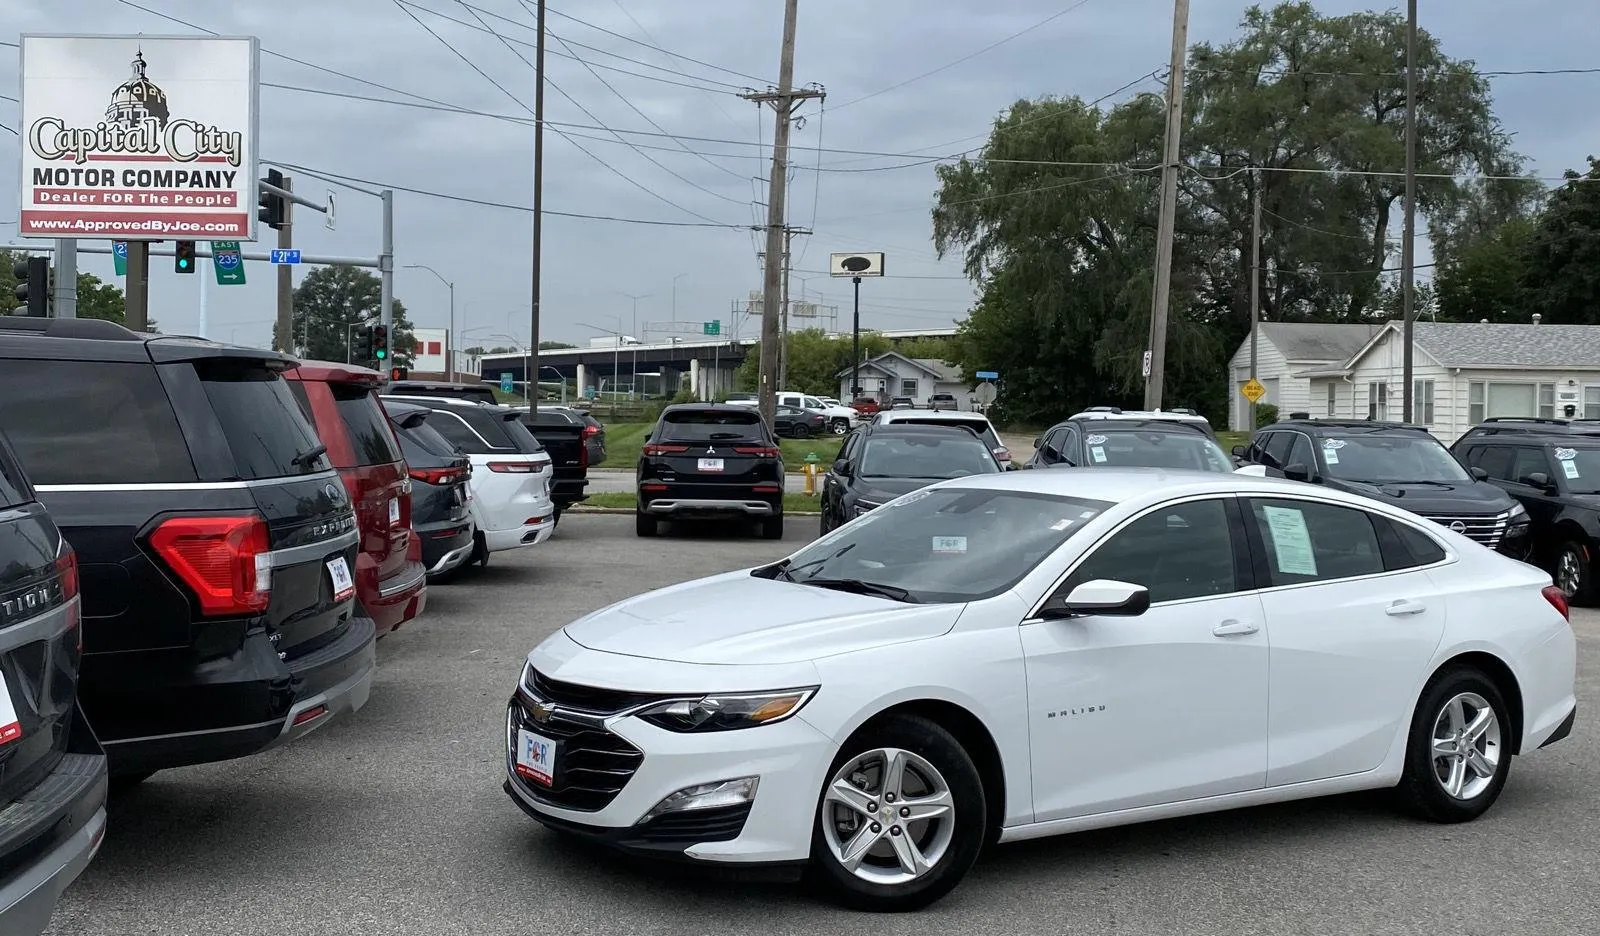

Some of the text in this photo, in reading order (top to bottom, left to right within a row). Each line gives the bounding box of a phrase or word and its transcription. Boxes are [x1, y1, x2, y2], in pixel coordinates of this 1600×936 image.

[29, 116, 242, 167] Capital City
[33, 167, 237, 189] MOTOR COMPANY
[40, 191, 231, 206] Dealer FOR The People
[29, 219, 239, 233] www.ApprovedByJoe.com
[213, 241, 237, 249] EAST
[218, 255, 238, 265] 235
[1047, 704, 1106, 719] MALIBU
